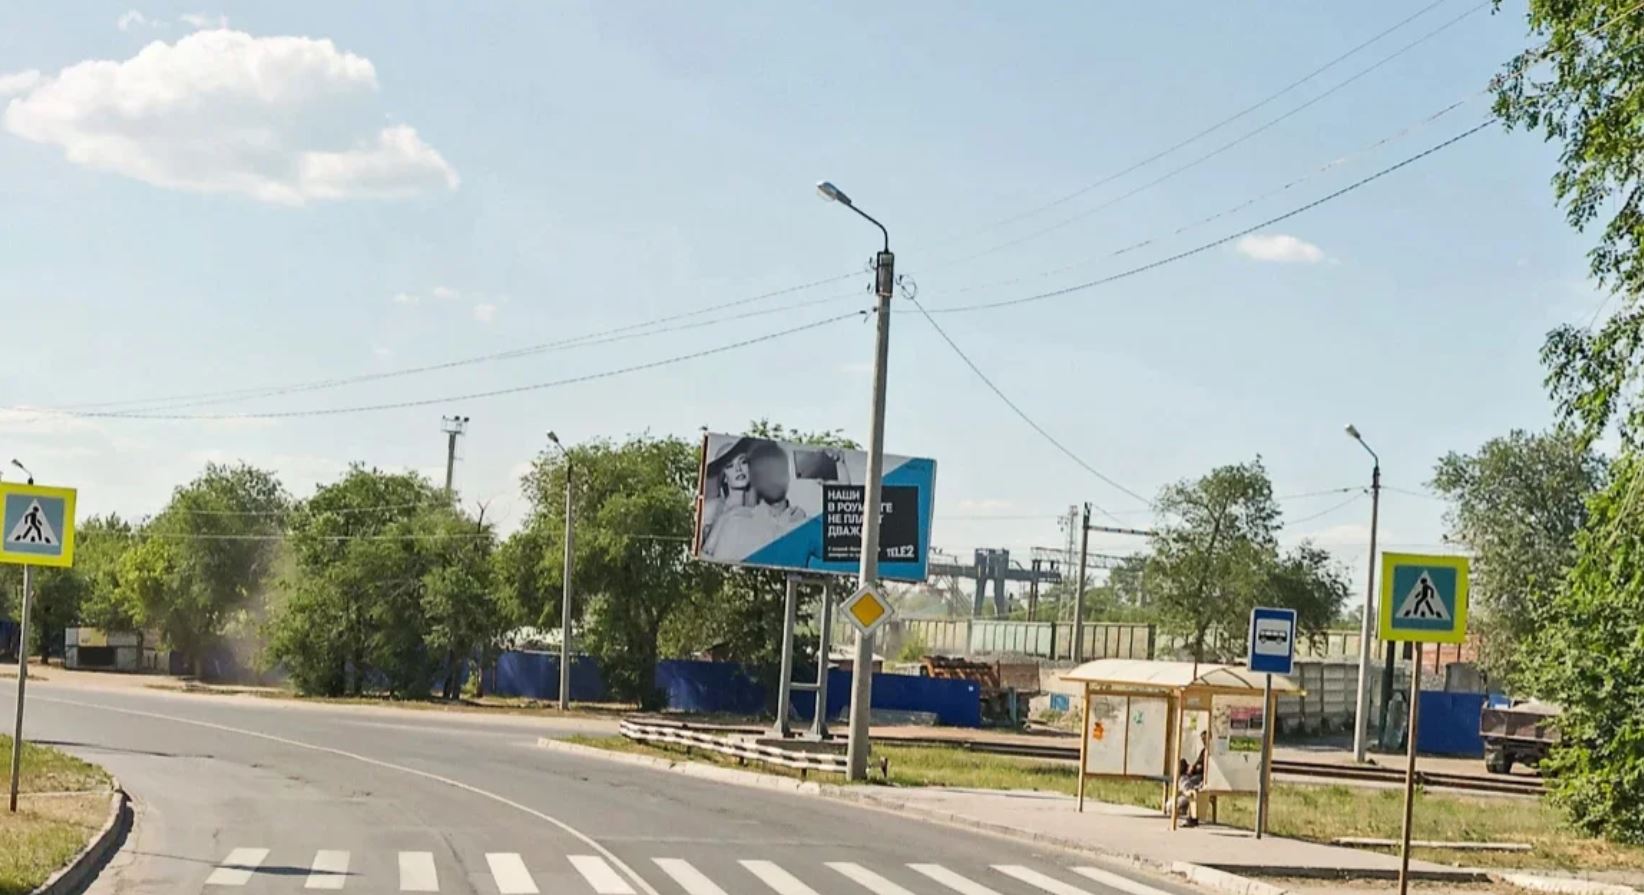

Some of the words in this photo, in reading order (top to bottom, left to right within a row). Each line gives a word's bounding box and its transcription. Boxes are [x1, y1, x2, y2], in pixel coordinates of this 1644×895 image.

[828, 490, 860, 500] НАШИ
[828, 502, 835, 512] В
[837, 502, 893, 513] РОУМГЕ
[828, 514, 842, 524] НЕ
[843, 514, 884, 524] ПЛАТ
[828, 526, 861, 538] ДВАЖ
[886, 545, 915, 558] TELE2
